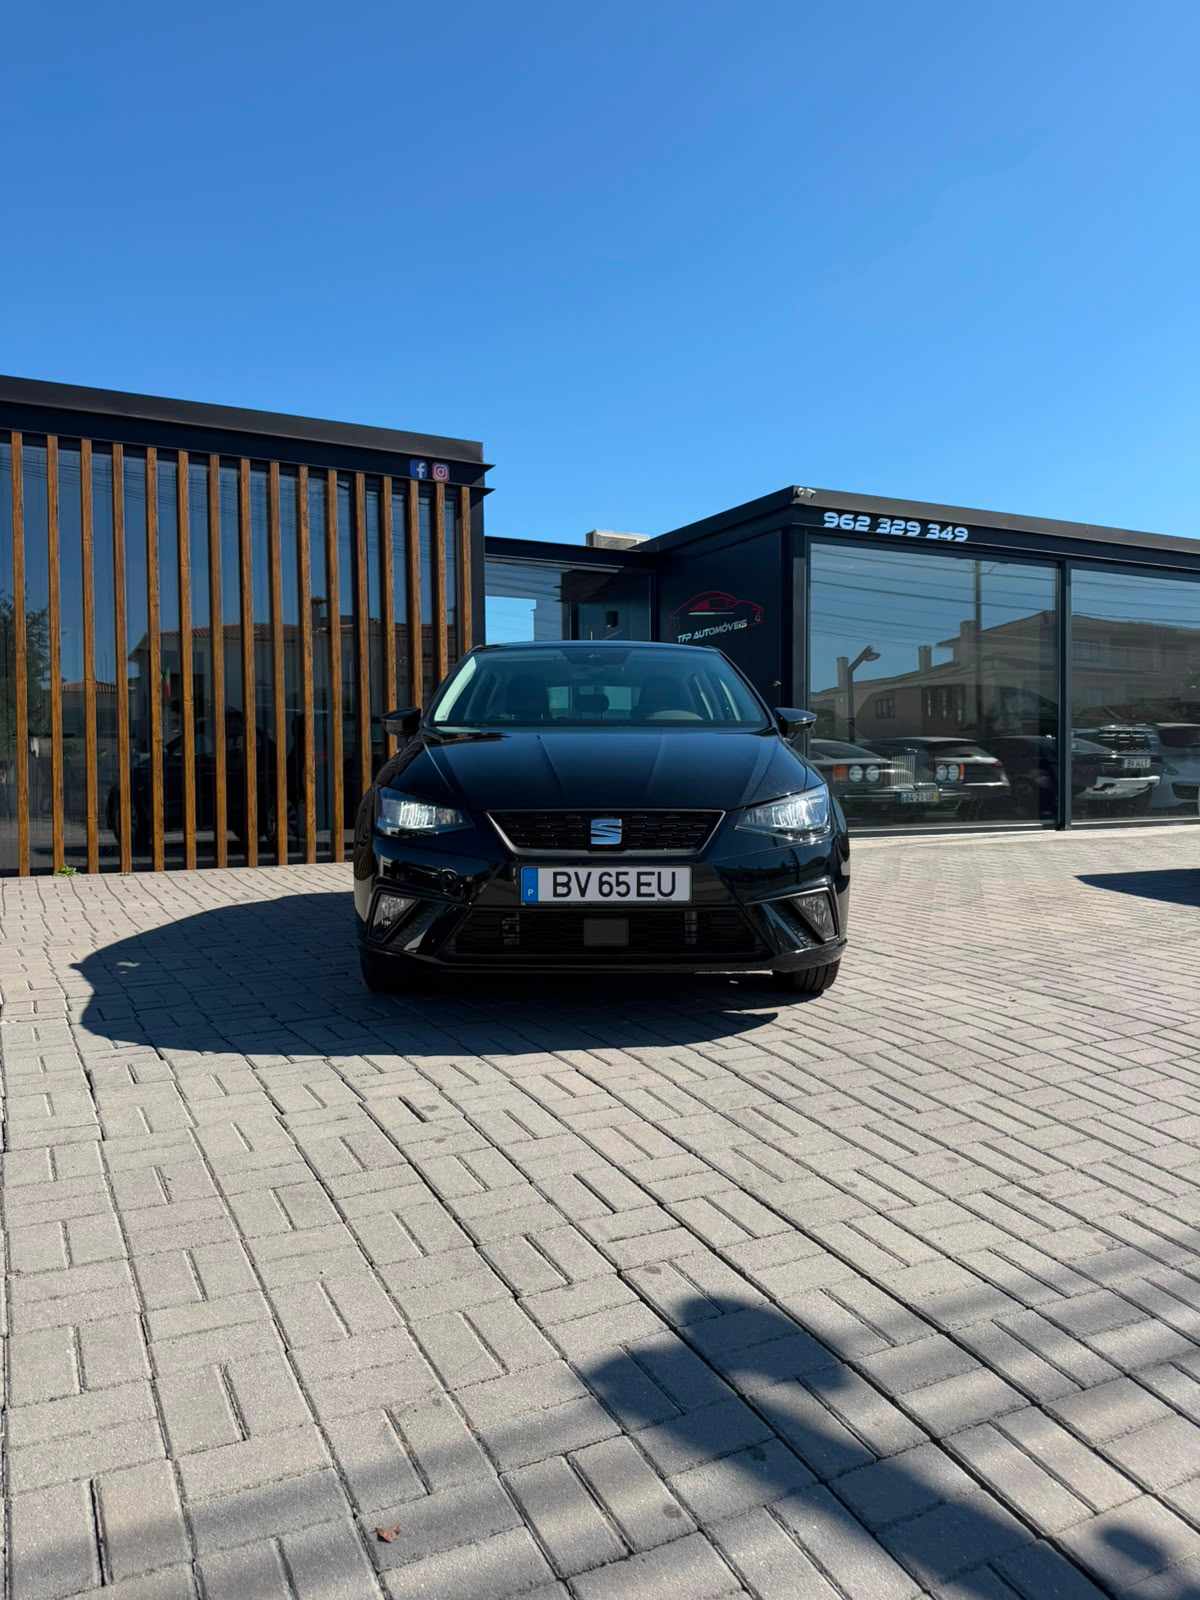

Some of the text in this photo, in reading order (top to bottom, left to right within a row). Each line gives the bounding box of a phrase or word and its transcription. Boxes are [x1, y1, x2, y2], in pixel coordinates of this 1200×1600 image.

[823, 511, 968, 543] 962 329 349
[677, 633, 692, 643] TFP
[552, 871, 592, 898] BV
[598, 871, 631, 898] 65
[636, 871, 676, 898] EU
